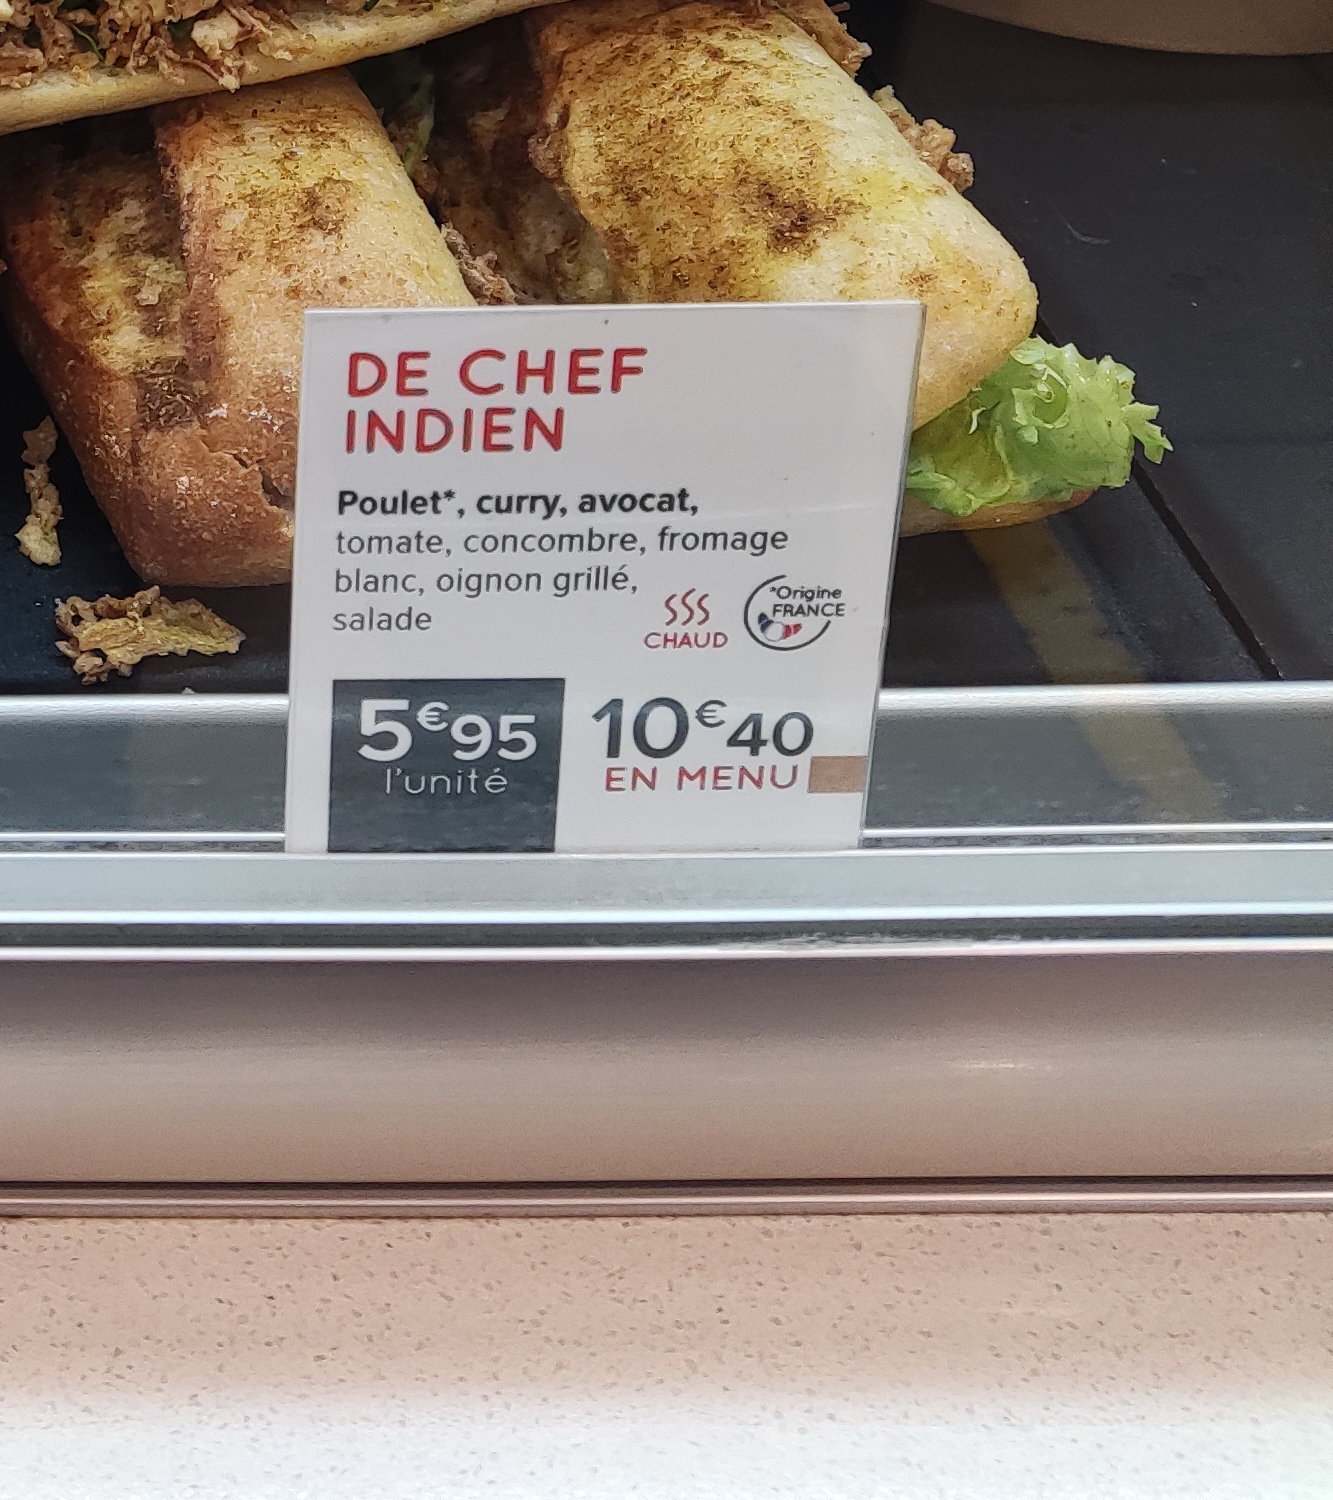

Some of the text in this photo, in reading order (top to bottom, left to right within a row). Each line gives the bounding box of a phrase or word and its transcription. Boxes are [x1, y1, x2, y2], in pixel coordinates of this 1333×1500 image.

[346, 346, 648, 399] DE CHEF
[343, 406, 566, 454] INDIEN
[476, 491, 569, 520] curry,
[577, 487, 699, 516] avocat,
[335, 525, 789, 558] tomate, concombre, fromage
[334, 564, 638, 599] blanc, oignon grillé,
[332, 607, 432, 633] salade
[771, 602, 846, 619] FRANCE
[643, 631, 729, 650] CHAUD
[384, 766, 508, 795] l'unité
[604, 763, 800, 793] EN MENU
